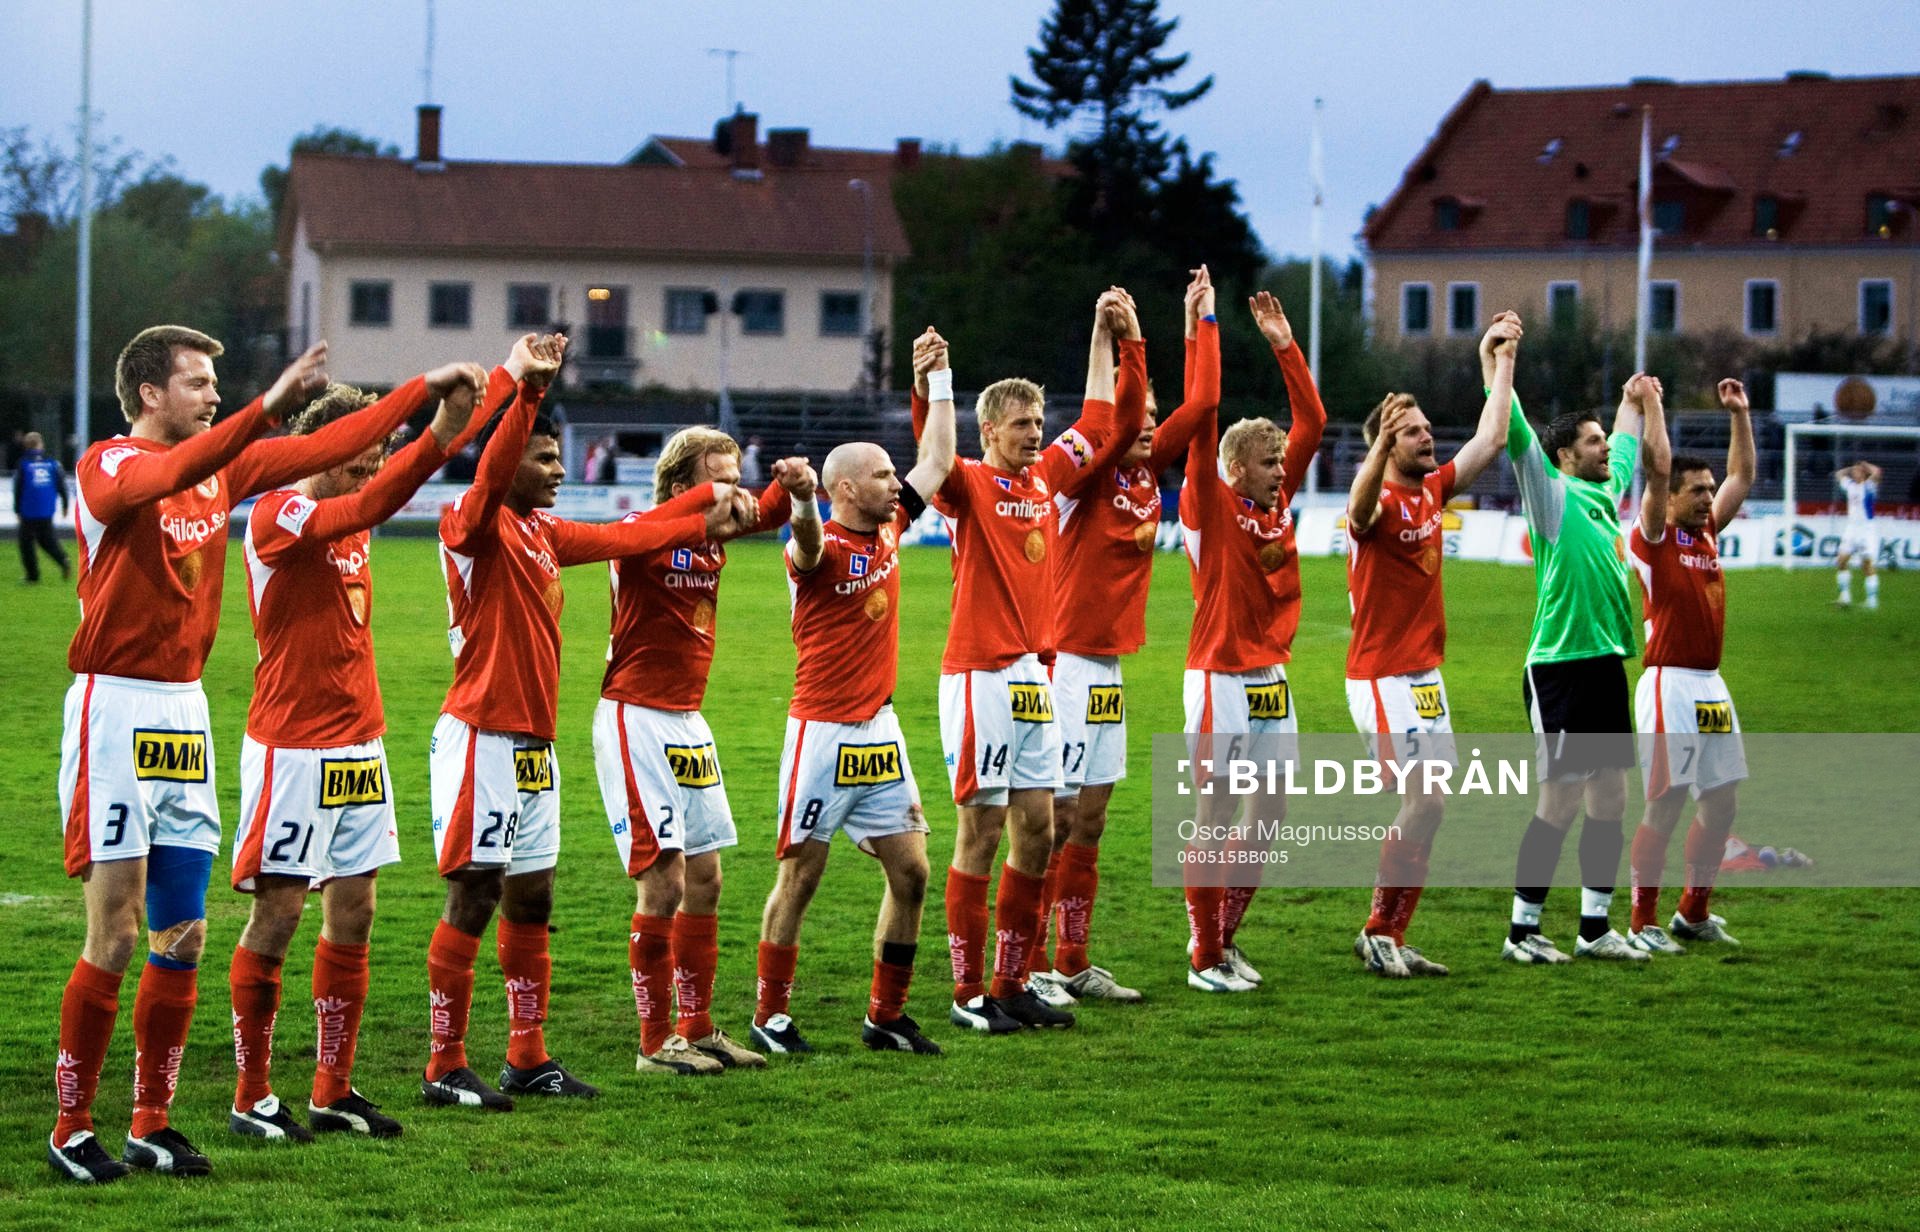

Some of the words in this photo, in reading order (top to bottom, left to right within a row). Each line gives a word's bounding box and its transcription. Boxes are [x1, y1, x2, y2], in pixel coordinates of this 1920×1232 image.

[1248, 688, 1283, 712] BM
[138, 741, 203, 772] BMK
[1226, 735, 1242, 765] 6
[1405, 727, 1420, 757] 5
[842, 752, 895, 777] BMK
[981, 743, 1008, 776] 14
[1680, 746, 1695, 775] 7
[328, 768, 382, 797] BMK
[103, 803, 128, 846] 3
[478, 811, 518, 848] 28
[658, 805, 673, 838] 2
[800, 799, 824, 830] 8
[269, 821, 314, 863] 21
[323, 1015, 349, 1067] online
[158, 1046, 185, 1091] online
